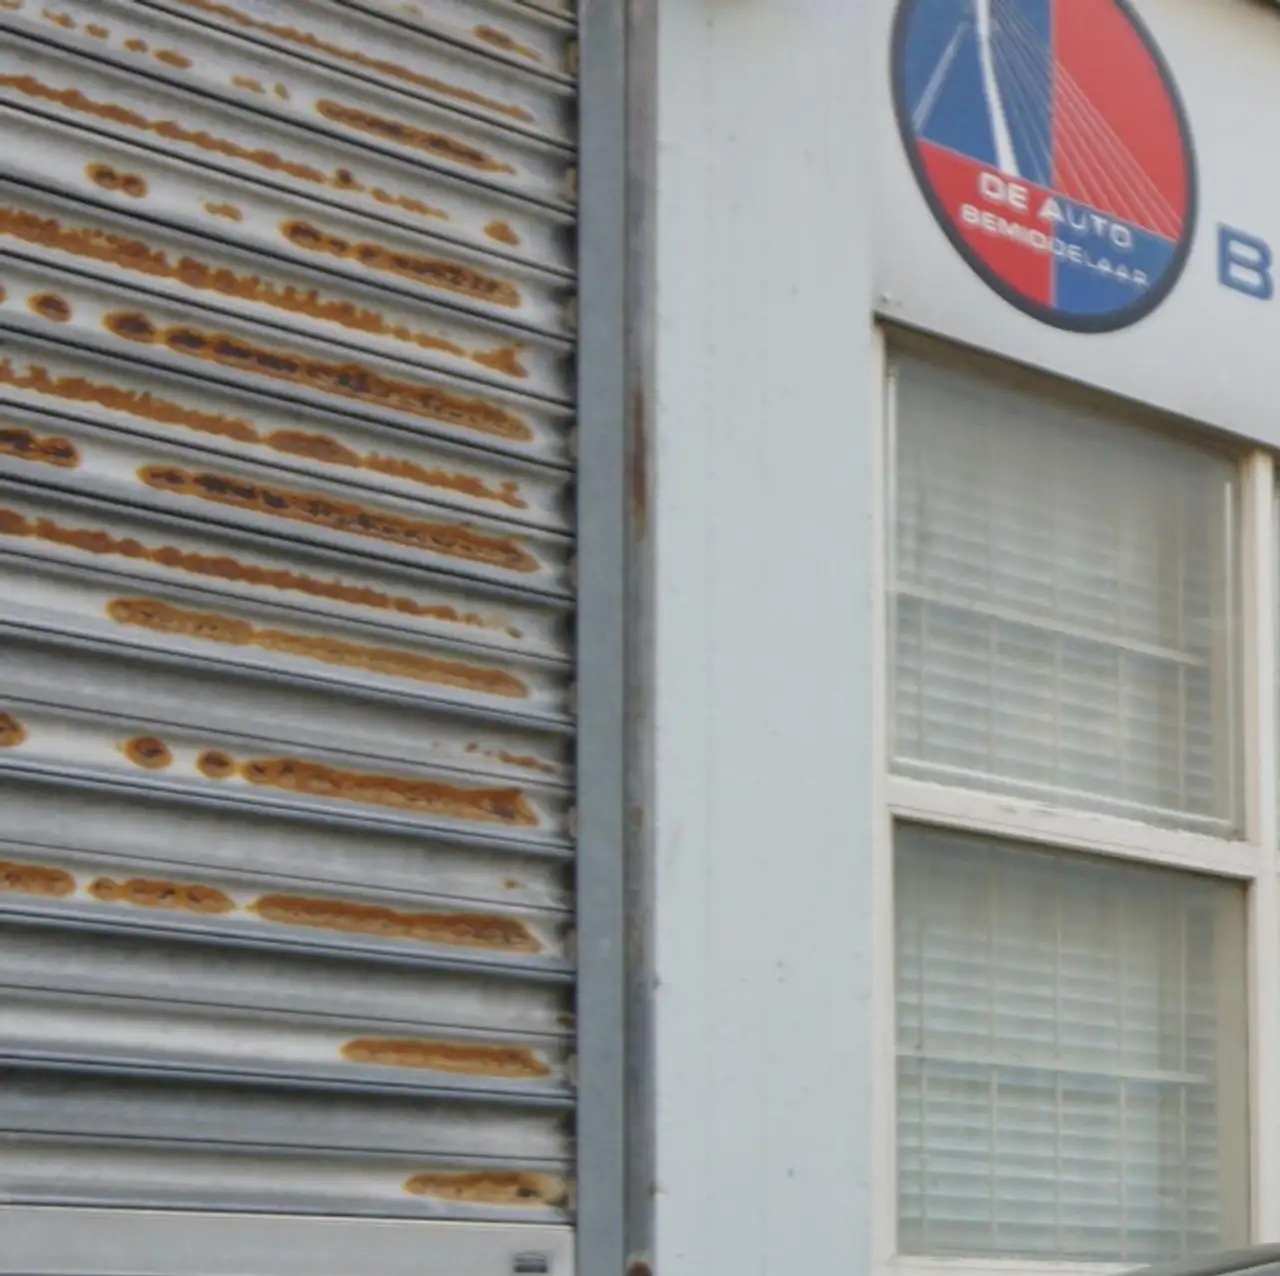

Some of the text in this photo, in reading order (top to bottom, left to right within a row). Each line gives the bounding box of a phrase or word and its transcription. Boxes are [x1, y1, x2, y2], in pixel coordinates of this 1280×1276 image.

[960, 203, 1151, 286] BEMIDDELAAR
[980, 170, 1134, 249] DE AUTO
